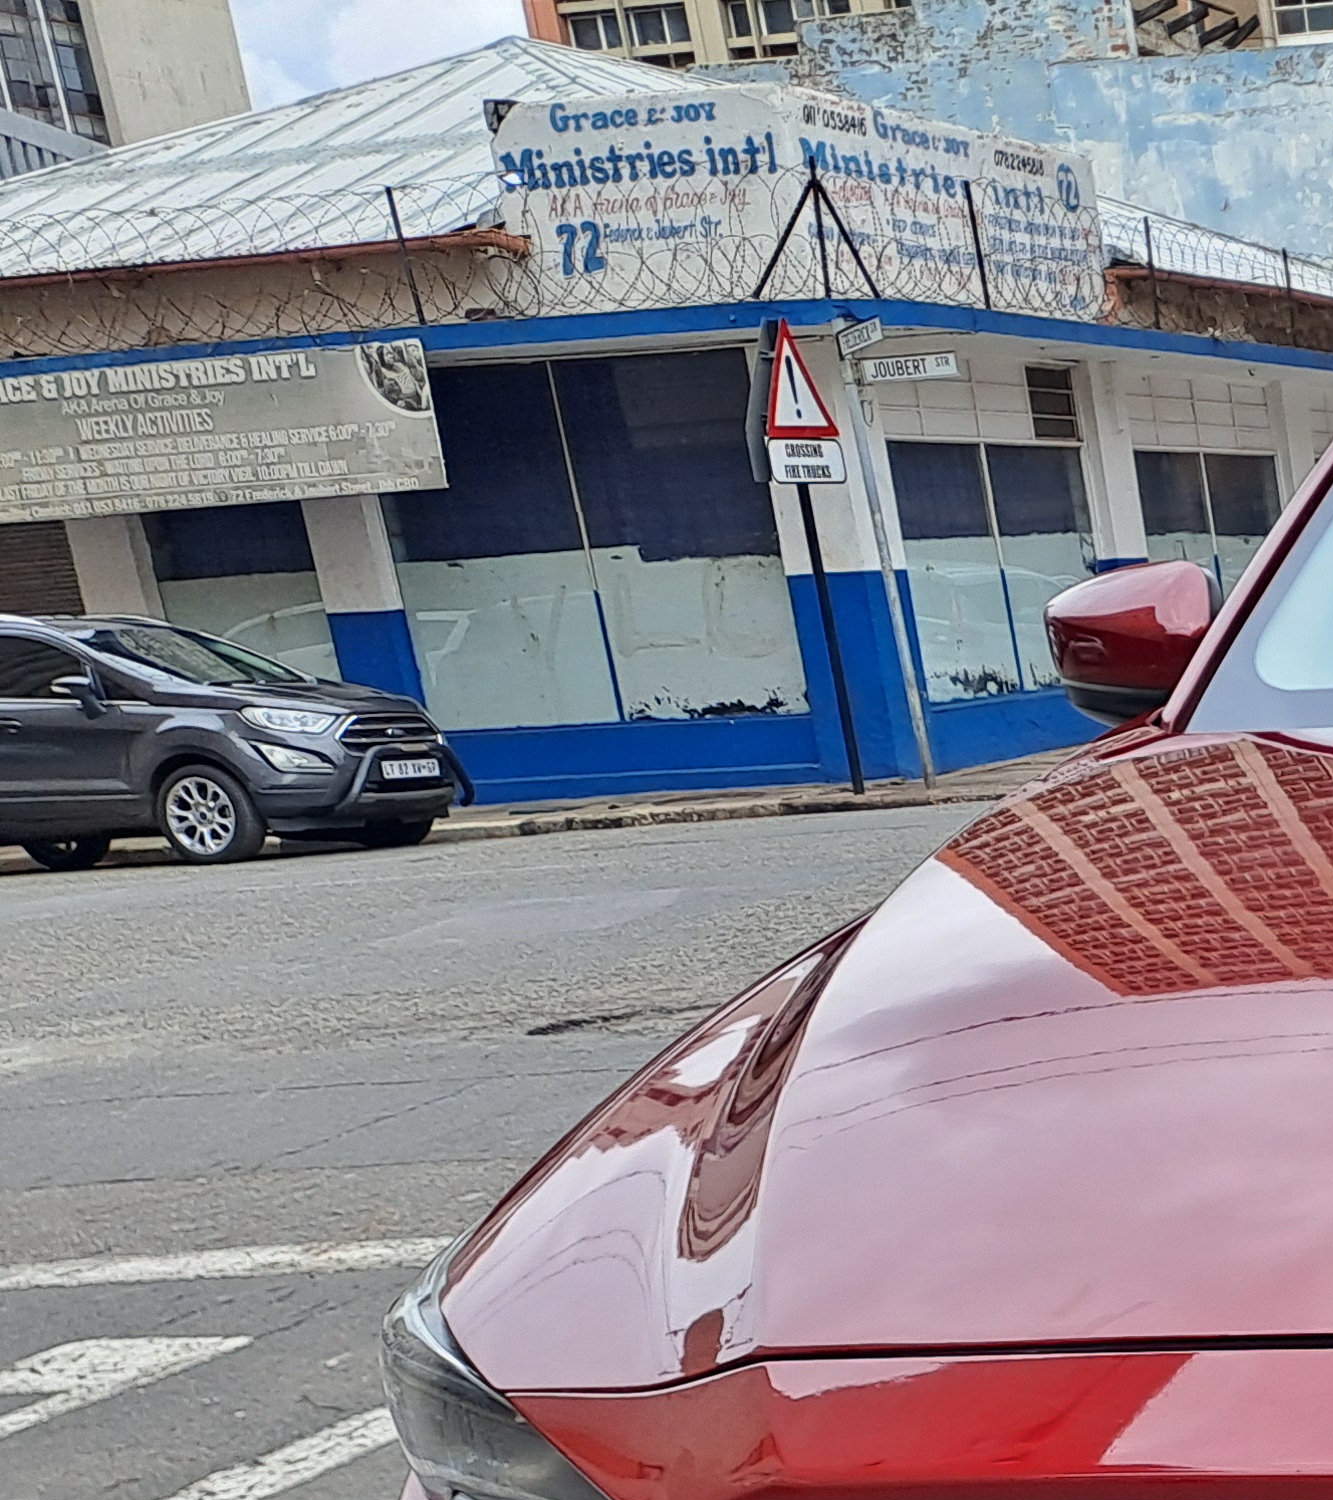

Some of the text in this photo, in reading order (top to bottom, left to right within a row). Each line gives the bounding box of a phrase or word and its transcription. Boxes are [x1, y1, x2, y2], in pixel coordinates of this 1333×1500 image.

[550, 103, 639, 133] Grace
[873, 109, 931, 150] Grace
[500, 140, 696, 193] Ministries
[549, 193, 584, 219] AKA
[555, 219, 606, 278] 72
[40, 373, 59, 400] &
[61, 367, 101, 399] JOY
[104, 358, 246, 394] MINISTRIES
[249, 352, 317, 382] INT'L
[871, 356, 950, 379] JOUBERT STR
[62, 399, 90, 416] AKA
[91, 395, 130, 414] Arena
[149, 390, 188, 408] Grace
[189, 389, 203, 406] &
[204, 388, 226, 407] Joy
[75, 408, 215, 442] WEEKLY ACTIVITIES
[289, 424, 330, 444] SERVICE
[785, 443, 824, 458] CROSSING
[784, 464, 801, 479] FIRE
